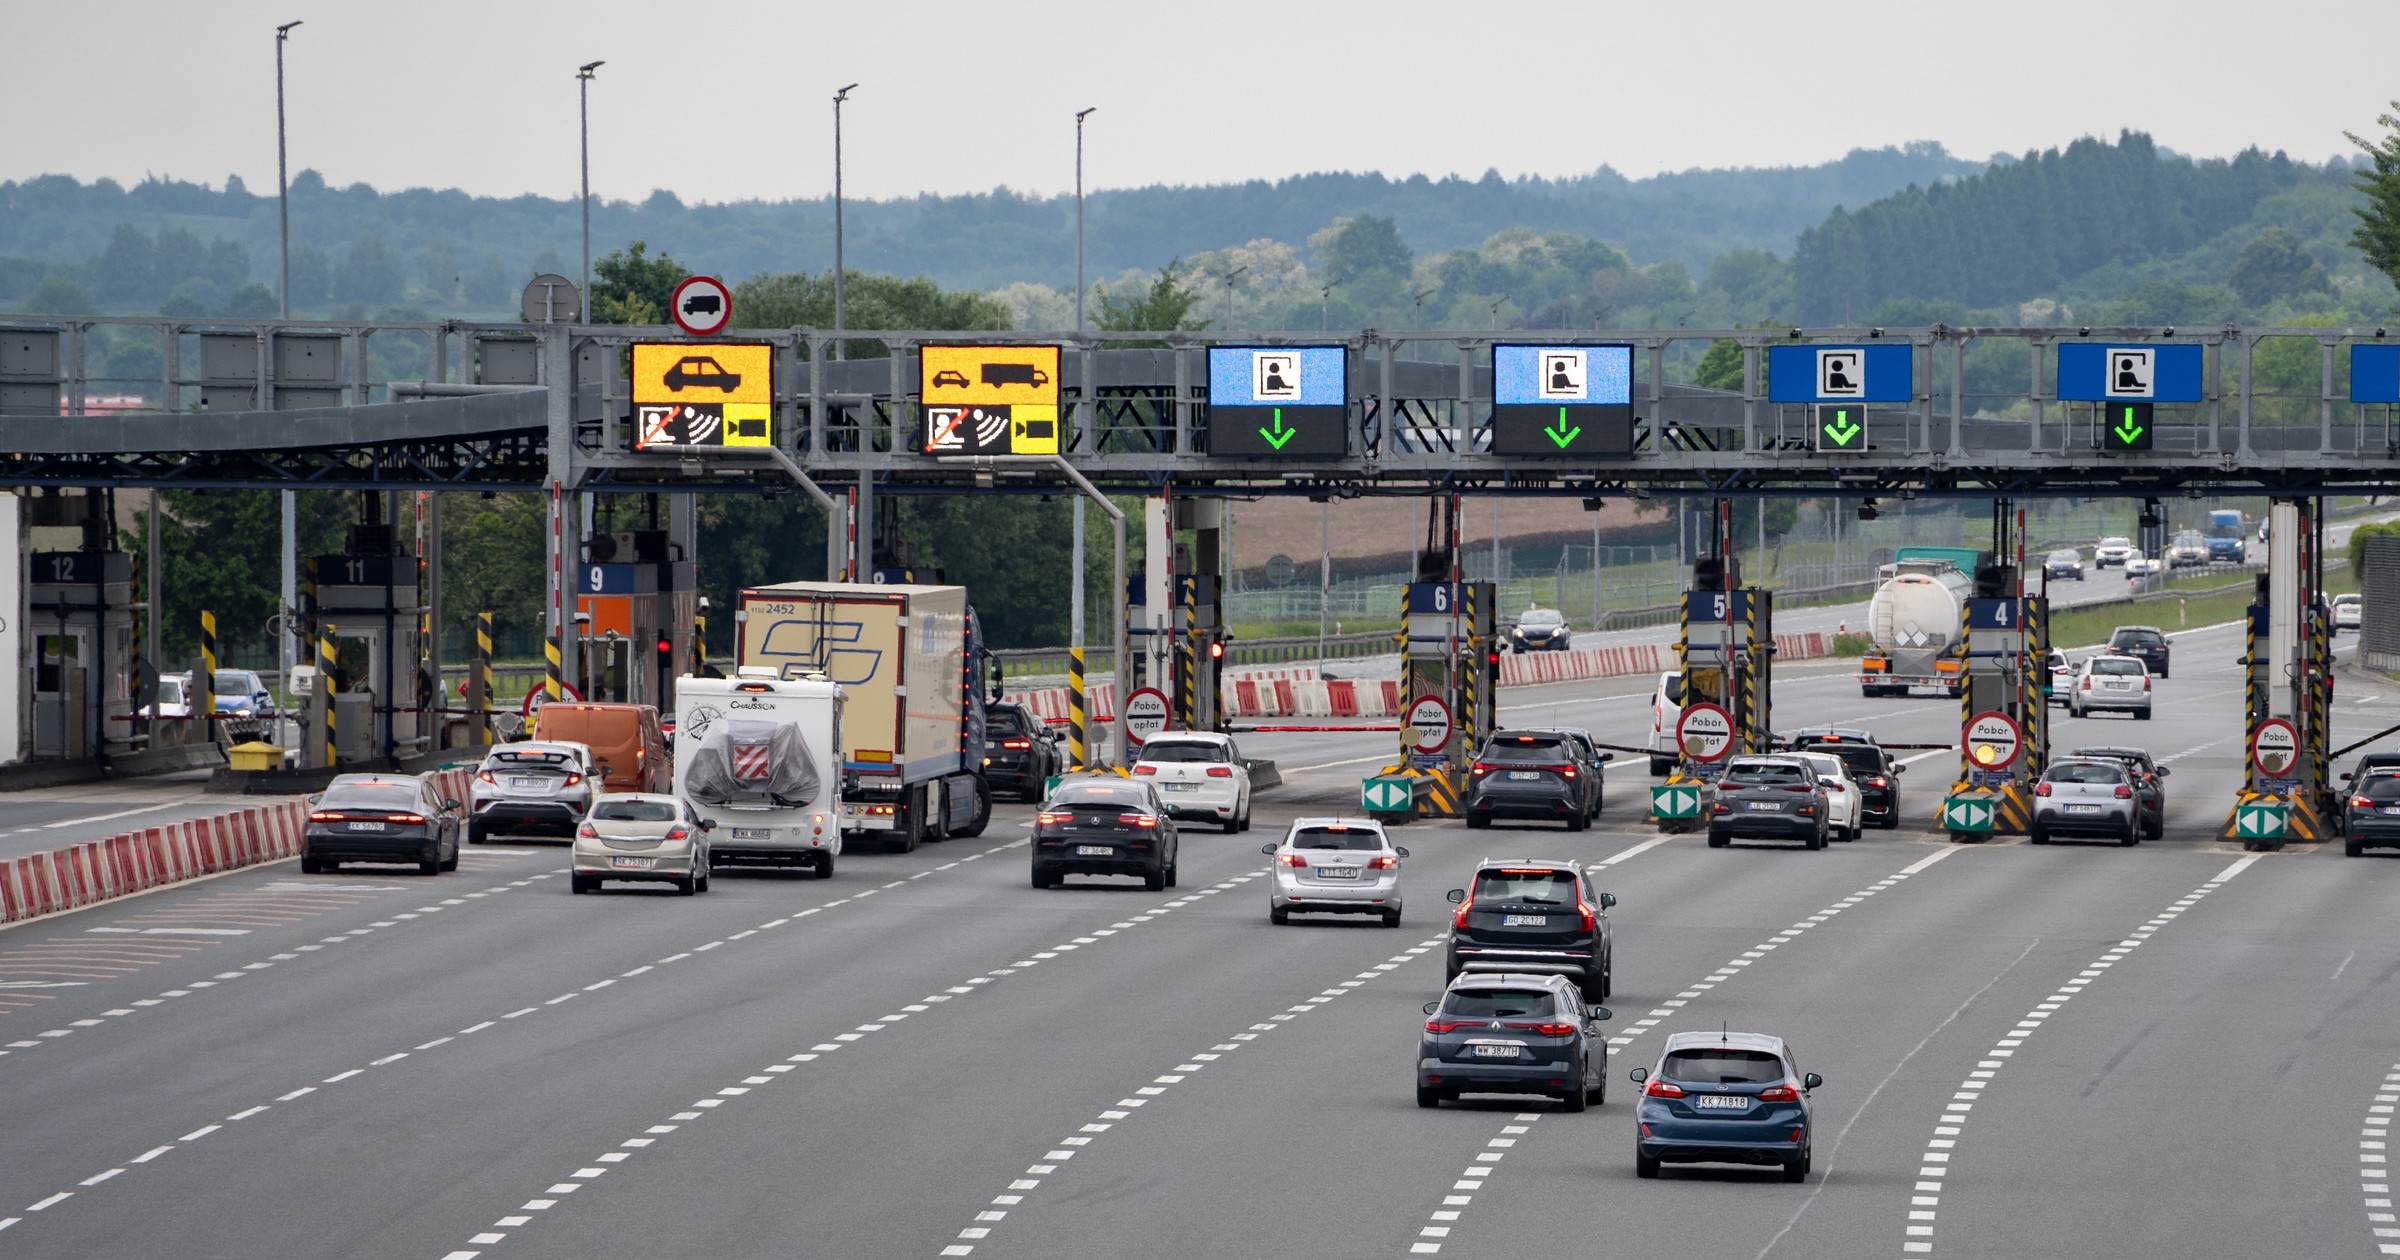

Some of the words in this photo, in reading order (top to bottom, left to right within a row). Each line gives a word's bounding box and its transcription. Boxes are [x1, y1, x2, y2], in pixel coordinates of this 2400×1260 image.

[51, 556, 74, 580] 12
[345, 559, 364, 582] 11
[590, 566, 603, 591] 9
[1435, 586, 1446, 611] 6
[766, 603, 795, 615] 2452
[1714, 594, 1725, 618] 5
[1995, 602, 2008, 625] 4
[1134, 700, 1160, 710] Pobór
[1417, 708, 1442, 718] Pobór
[1134, 719, 1159, 731] opłat
[1691, 716, 1722, 727] Pobór
[1977, 724, 2008, 735] Pobór
[2263, 731, 2289, 742] Pobór
[1477, 1046, 1489, 1055] WW
[1491, 1046, 1518, 1056] 387TH
[1701, 1096, 1714, 1106] KK
[1716, 1097, 1746, 1107] 71818
